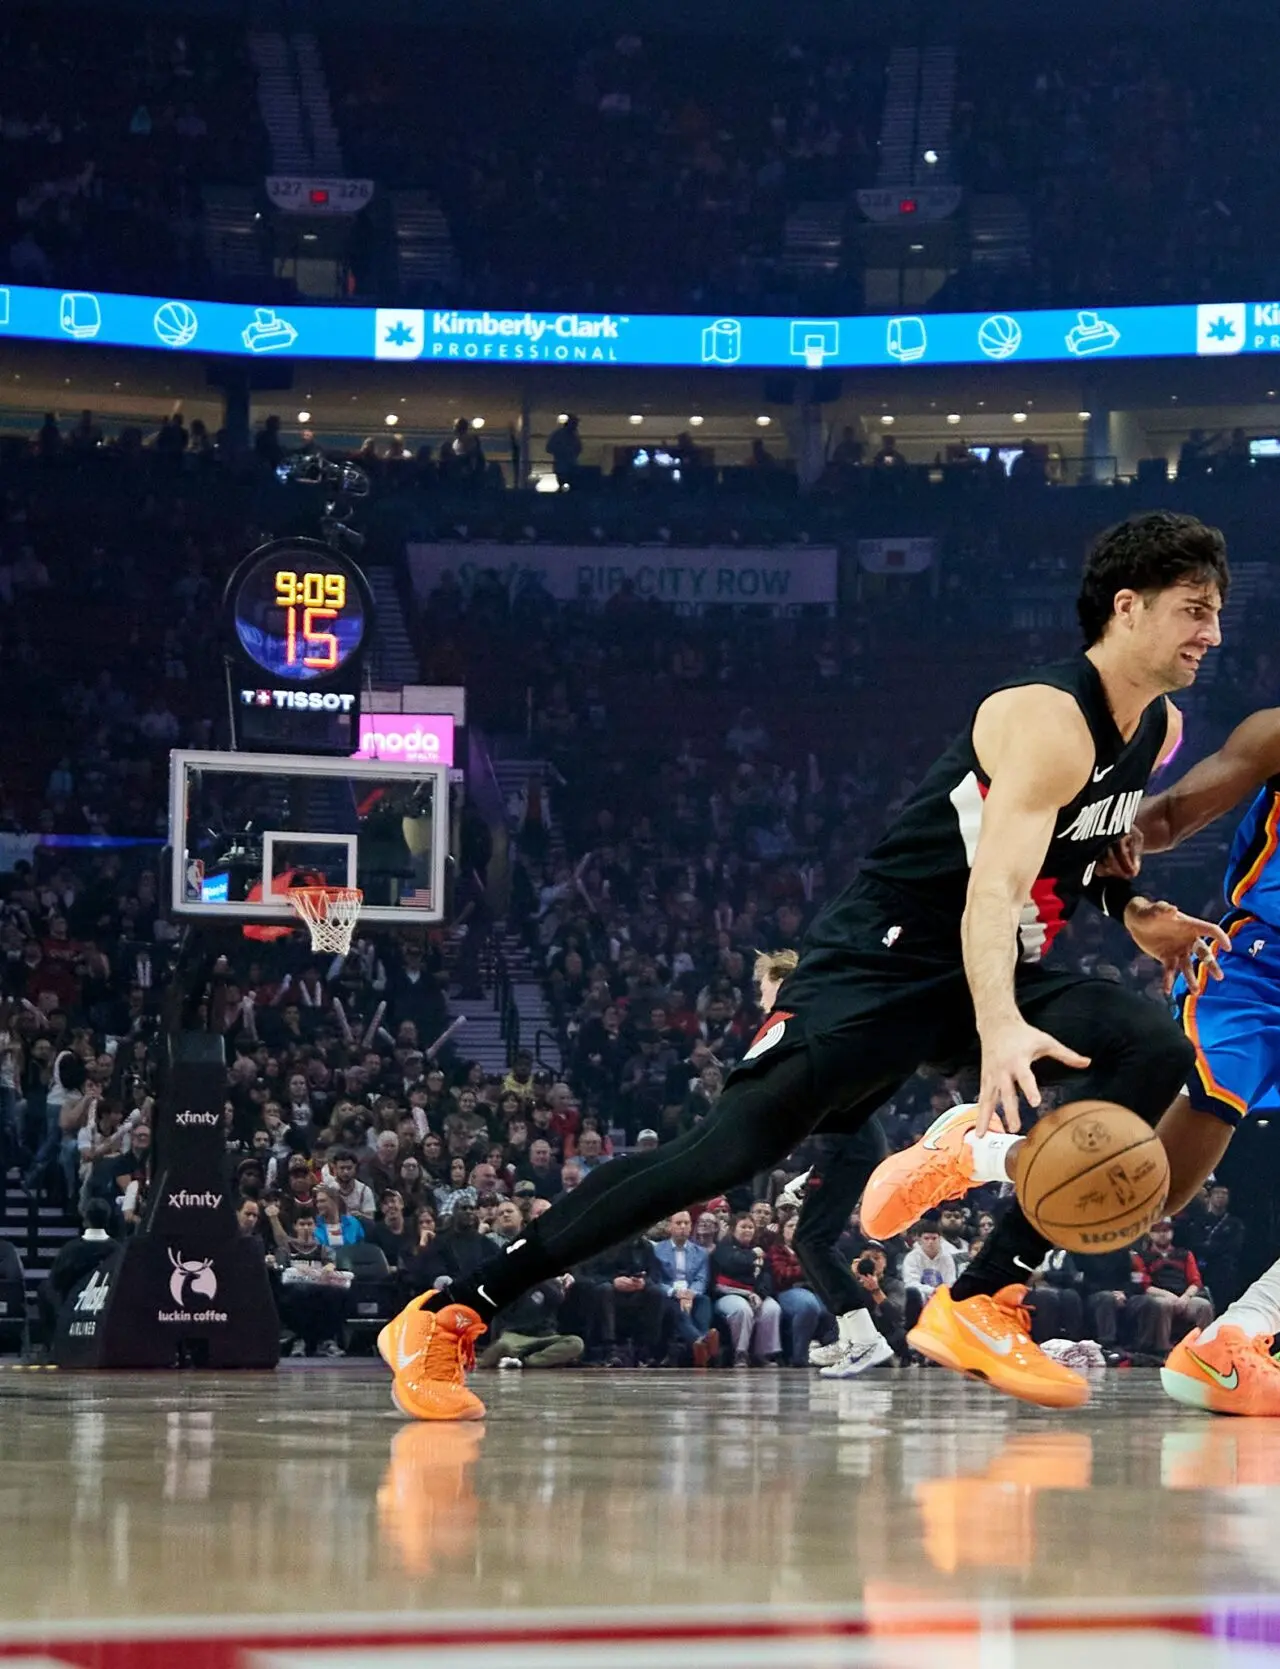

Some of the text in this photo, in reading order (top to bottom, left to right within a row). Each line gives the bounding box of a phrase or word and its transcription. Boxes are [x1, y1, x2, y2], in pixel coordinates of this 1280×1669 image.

[433, 343, 617, 360] PROFESSIONAL
[275, 571, 346, 609] 9:09
[634, 566, 707, 596] CITY
[716, 567, 792, 596] ROW
[287, 606, 338, 668] 15
[272, 690, 355, 710] TISSOT
[362, 728, 440, 752] moda
[175, 1110, 219, 1125] xfinity
[168, 1189, 222, 1208] xfinity
[158, 1310, 227, 1321] luckin coffee
